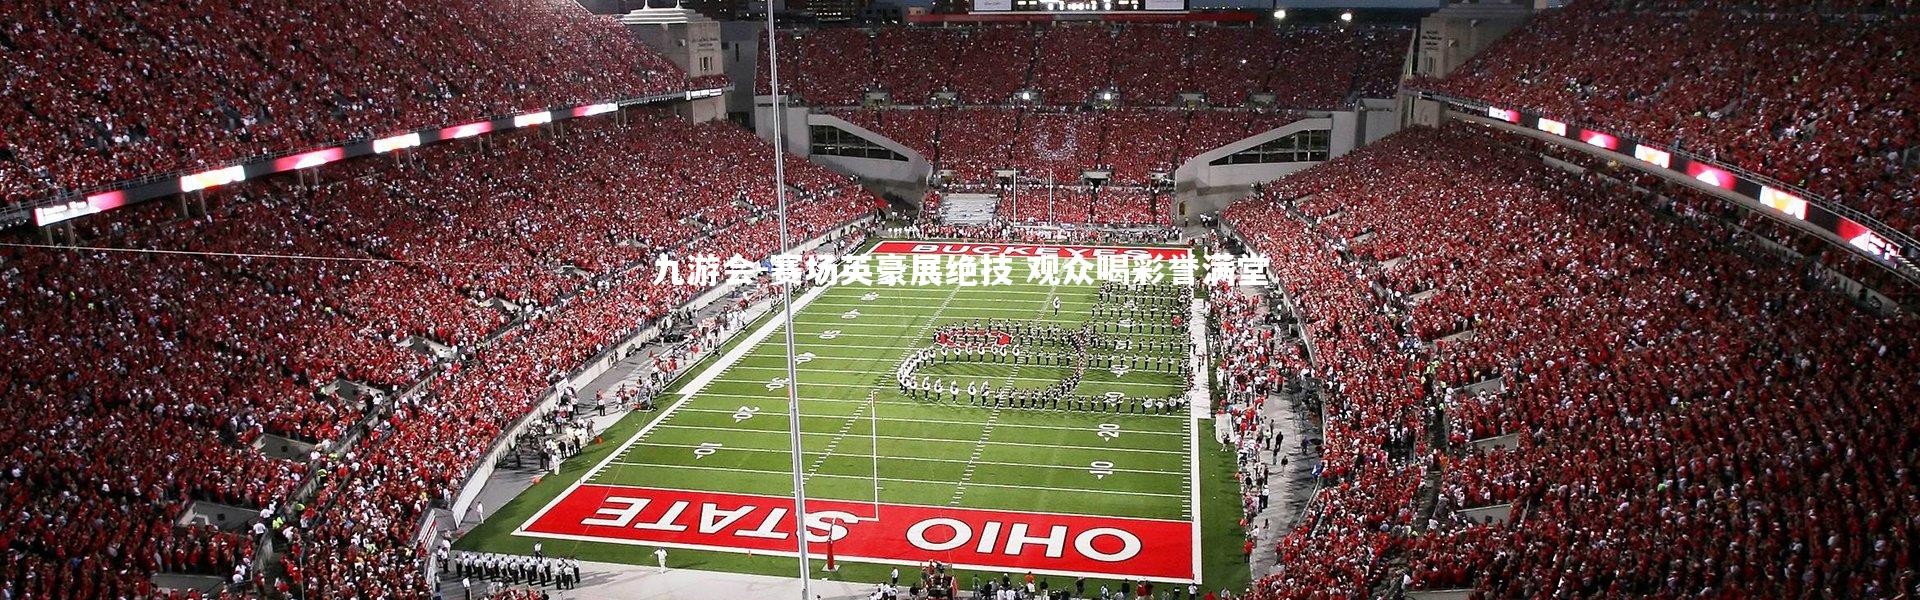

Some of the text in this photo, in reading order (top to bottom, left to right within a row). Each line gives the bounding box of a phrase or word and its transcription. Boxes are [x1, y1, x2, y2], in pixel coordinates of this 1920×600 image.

[911, 244, 1149, 259] BUCKEYES
[1097, 423, 1120, 437] 20
[694, 442, 722, 455] 10
[1089, 461, 1113, 475] 10
[580, 496, 1142, 562] OHIO STATE
